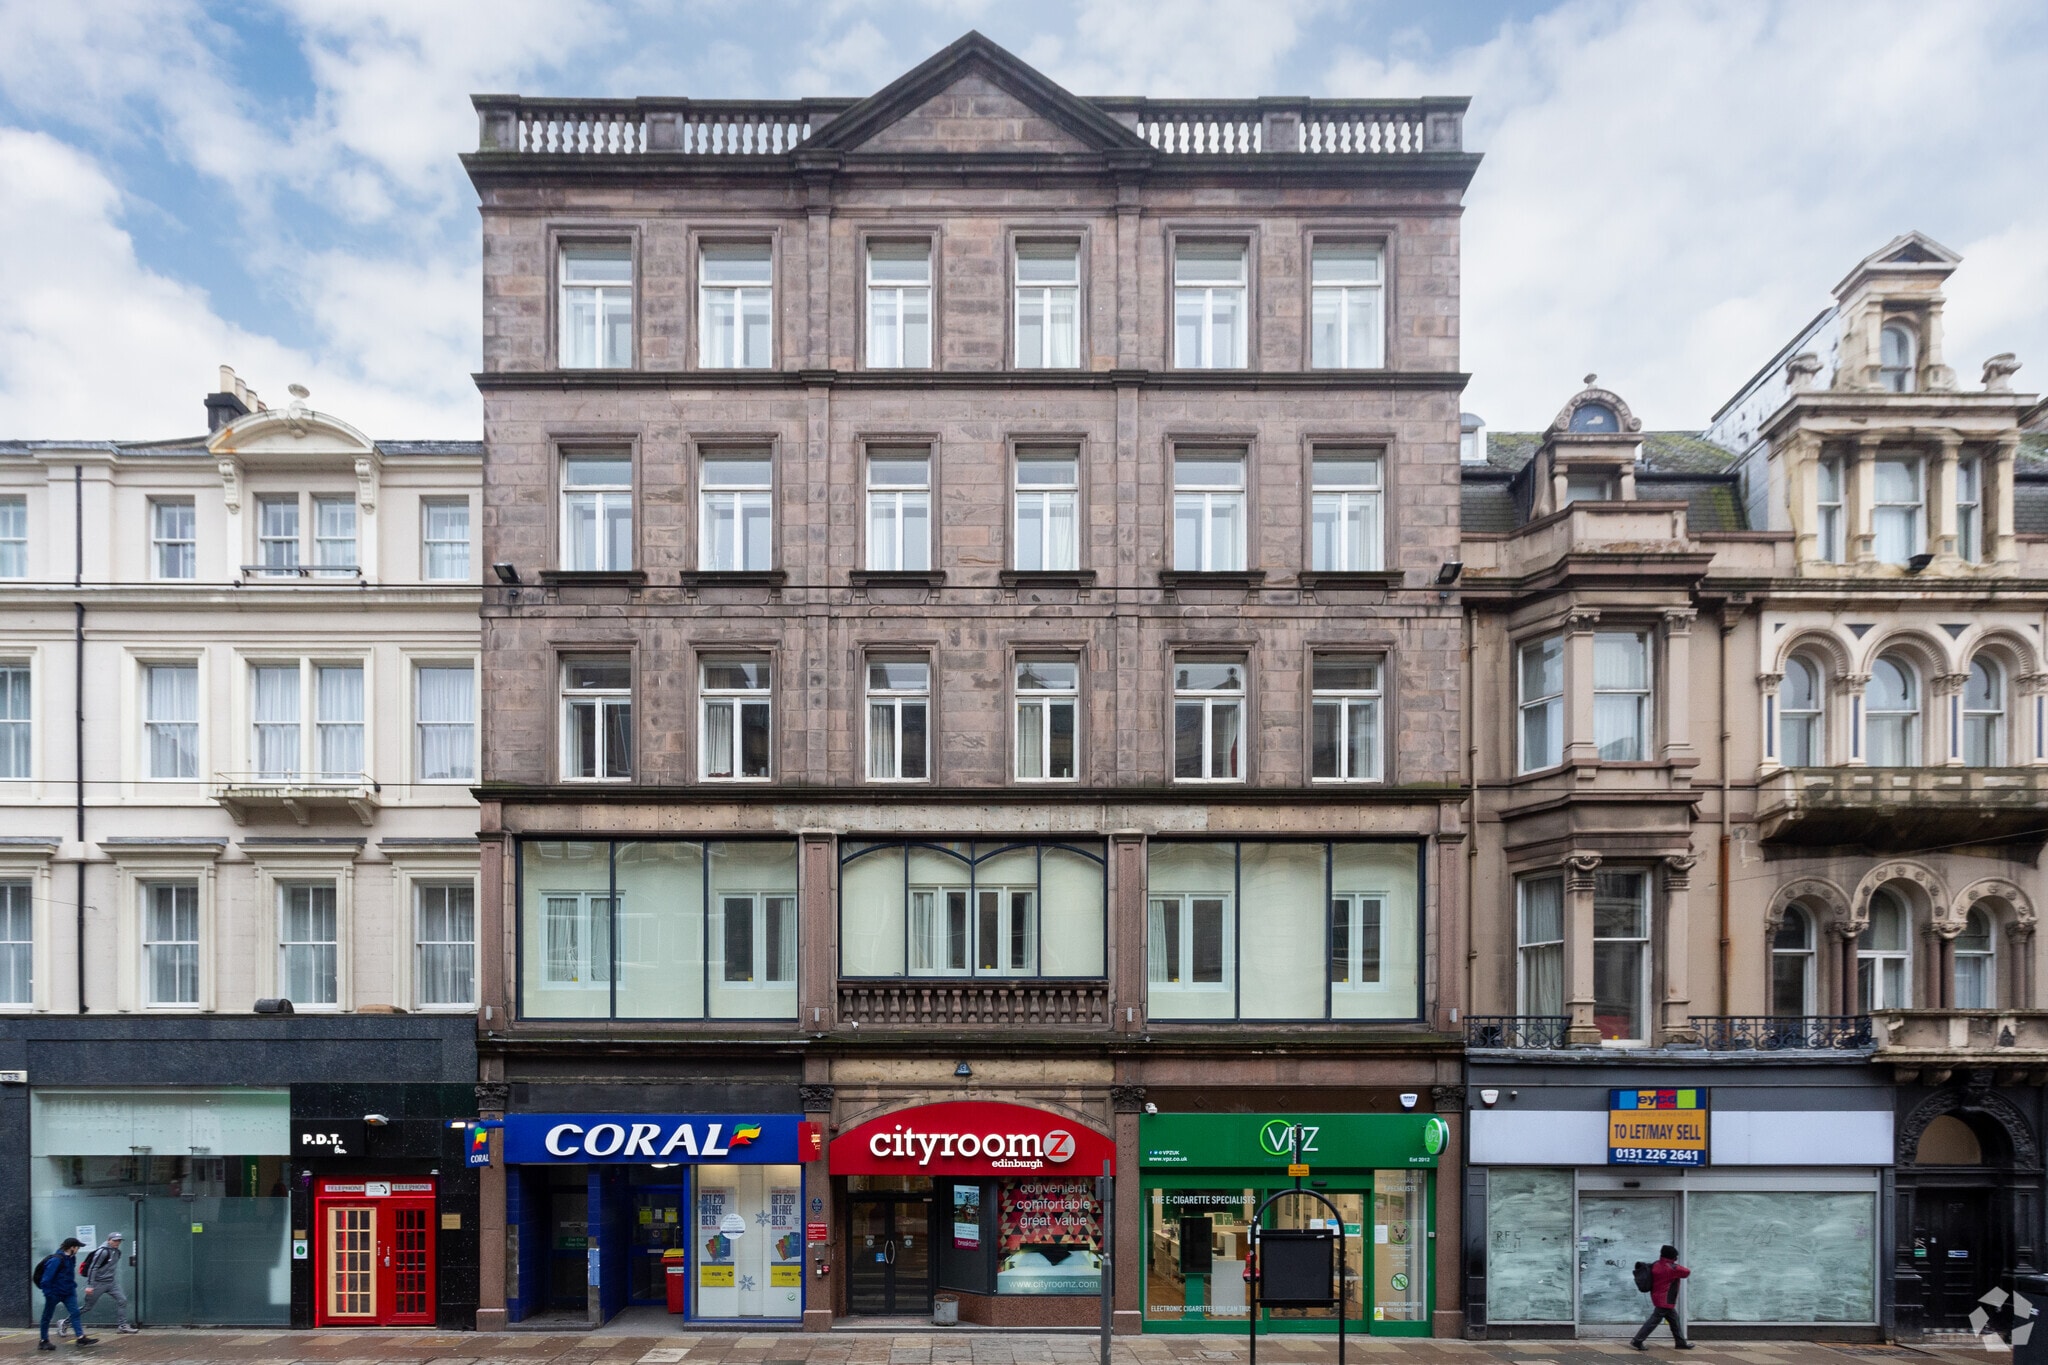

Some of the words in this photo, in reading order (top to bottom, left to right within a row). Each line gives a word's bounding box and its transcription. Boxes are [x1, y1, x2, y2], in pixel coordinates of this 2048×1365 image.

[1614, 1123, 1627, 1140] TO
[1630, 1124, 1674, 1140] LET/MAY
[1676, 1124, 1701, 1141] SELL
[302, 1133, 343, 1145] P.D.T.
[545, 1123, 729, 1156] CORAL
[470, 1154, 489, 1164] CORAL
[1615, 1148, 1643, 1159] 0131
[1645, 1149, 1667, 1160] 226
[1669, 1149, 1699, 1161] 2641
[991, 1158, 1044, 1170] edinburgh
[394, 1183, 431, 1191] TELEPHONE
[1020, 1183, 1087, 1194] convenient
[713, 1194, 726, 1205] £20
[771, 1194, 783, 1205] GET
[783, 1194, 796, 1205] £20
[1016, 1199, 1091, 1210] comfortable
[1151, 1196, 1165, 1205] THE
[1165, 1196, 1211, 1205] E-CIGARETTE
[1211, 1195, 1256, 1205] SPECIALISTS
[771, 1205, 779, 1216] IN
[780, 1205, 792, 1216] FREE
[701, 1215, 717, 1226] BETS
[771, 1215, 787, 1226] BETS
[1020, 1215, 1052, 1229] great
[1055, 1215, 1087, 1226] value
[1008, 1279, 1098, 1291] www.cityroomz.com
